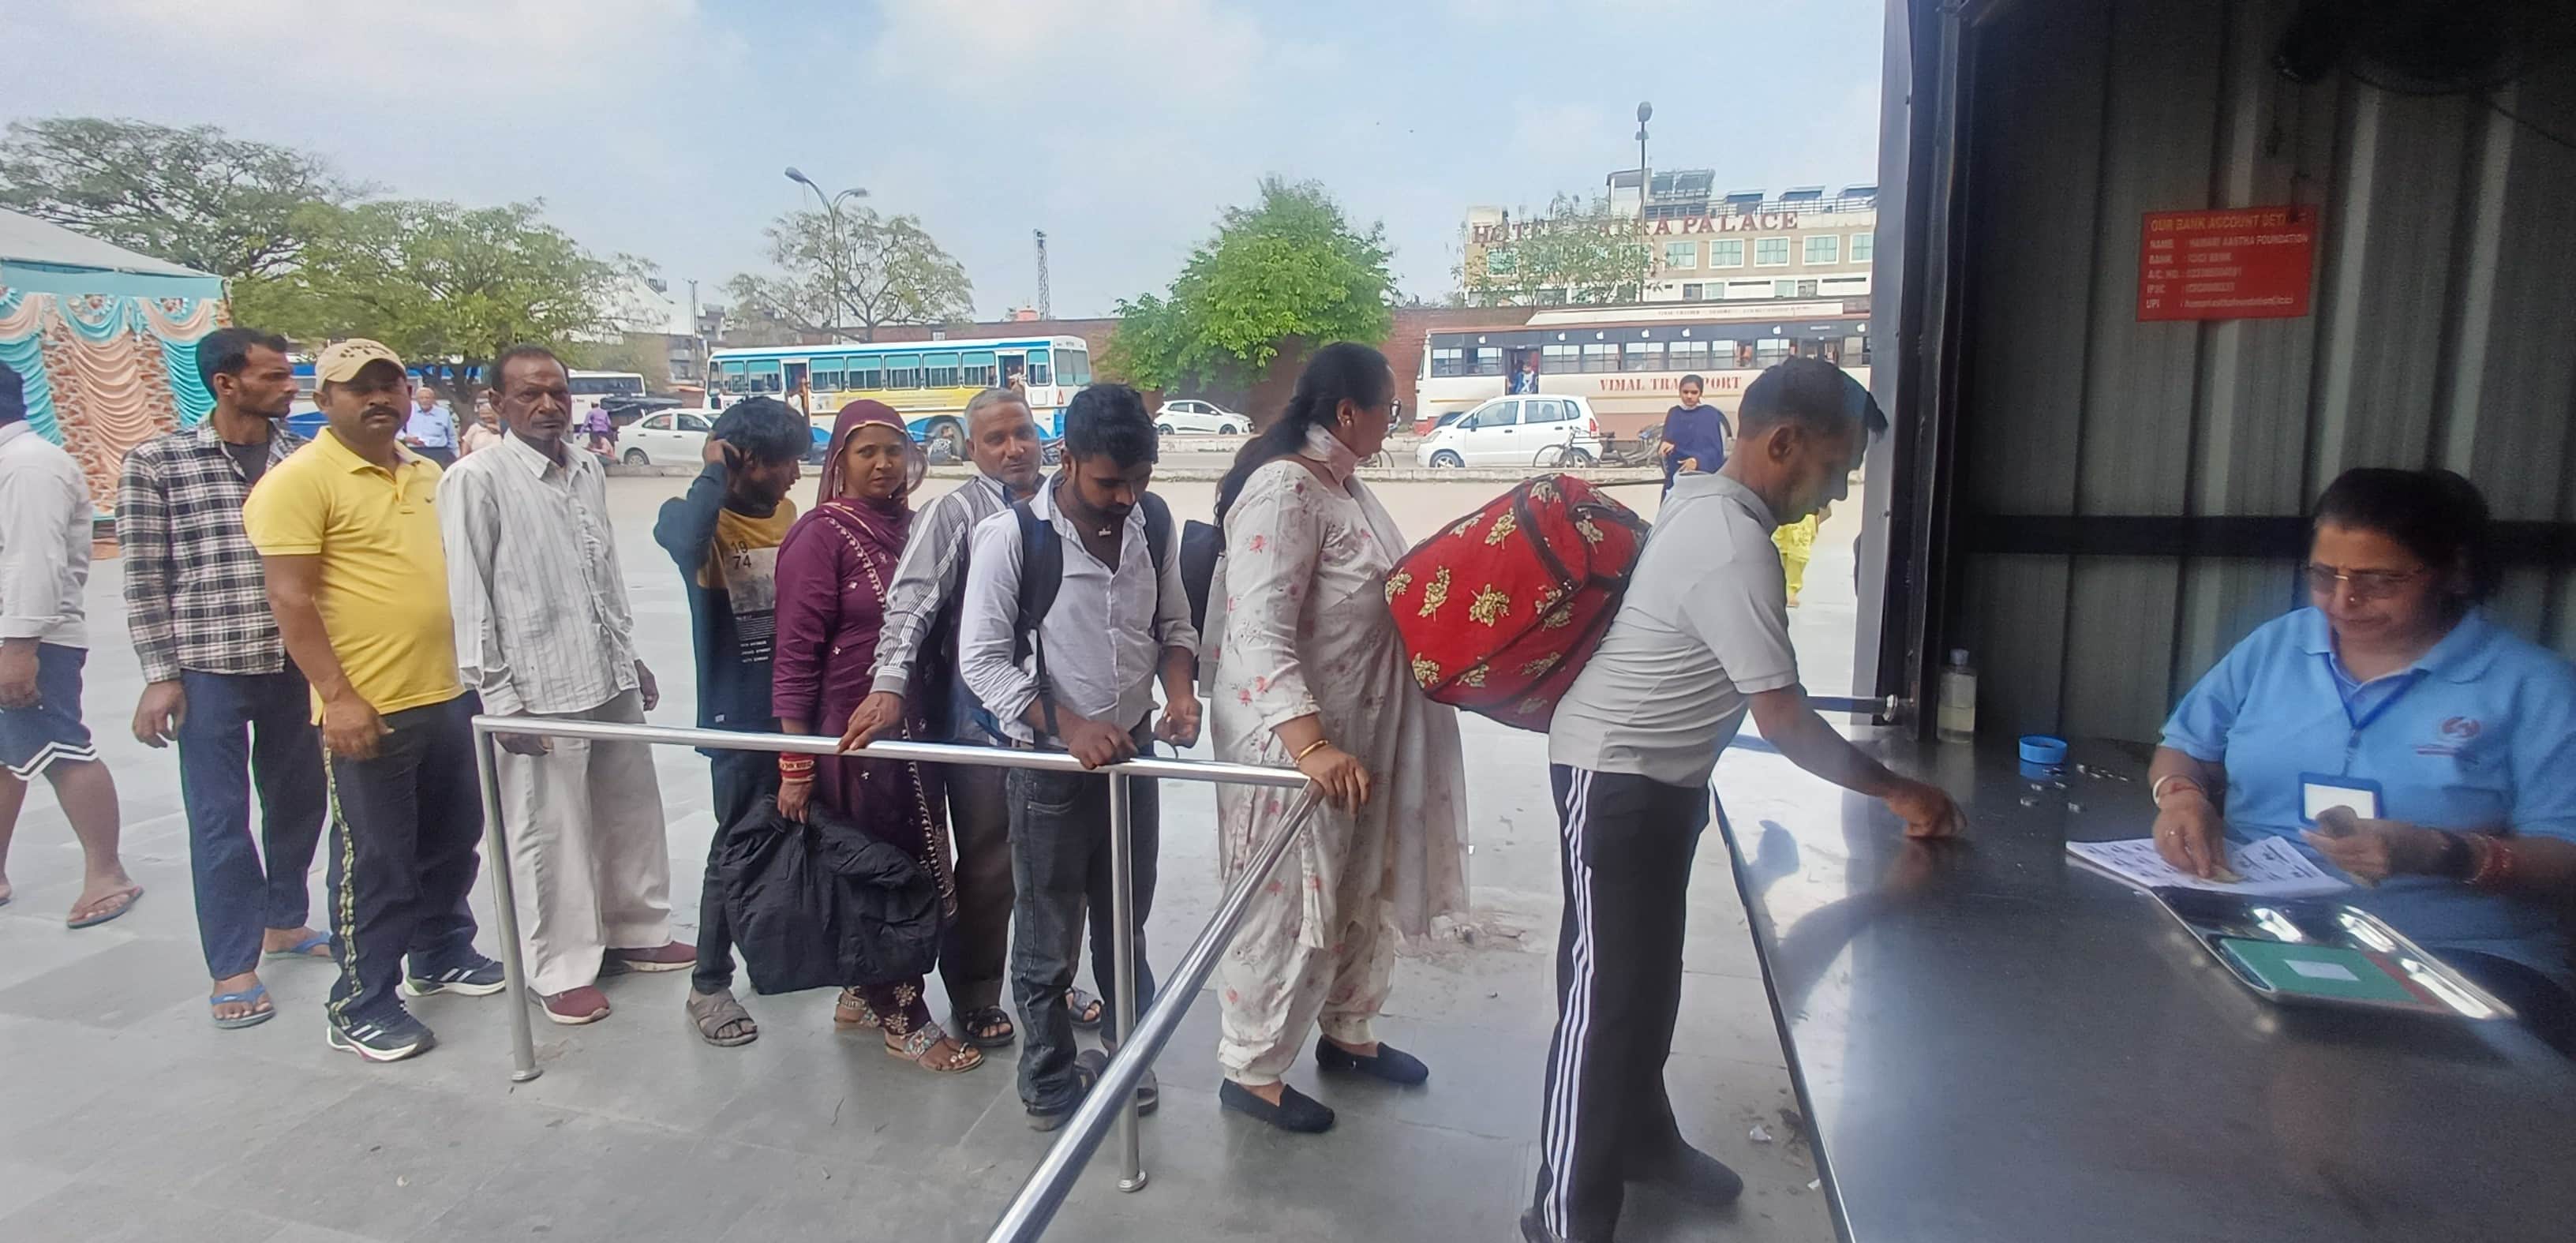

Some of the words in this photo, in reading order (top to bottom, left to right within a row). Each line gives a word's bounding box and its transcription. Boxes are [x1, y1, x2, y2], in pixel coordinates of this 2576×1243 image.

[1682, 211, 1798, 234] PALACE
[2151, 219, 2173, 231] OUR
[2176, 217, 2206, 230] BANK
[2208, 214, 2260, 230] ACCOUNT
[2150, 238, 2174, 249] NAME
[2256, 234, 2308, 245] FOUNDATION
[2148, 254, 2173, 264] BANK
[1600, 378, 1644, 391] VIMAL
[1650, 376, 1742, 391] TRAPORT
[731, 541, 749, 554] 19
[732, 555, 751, 569] 74
